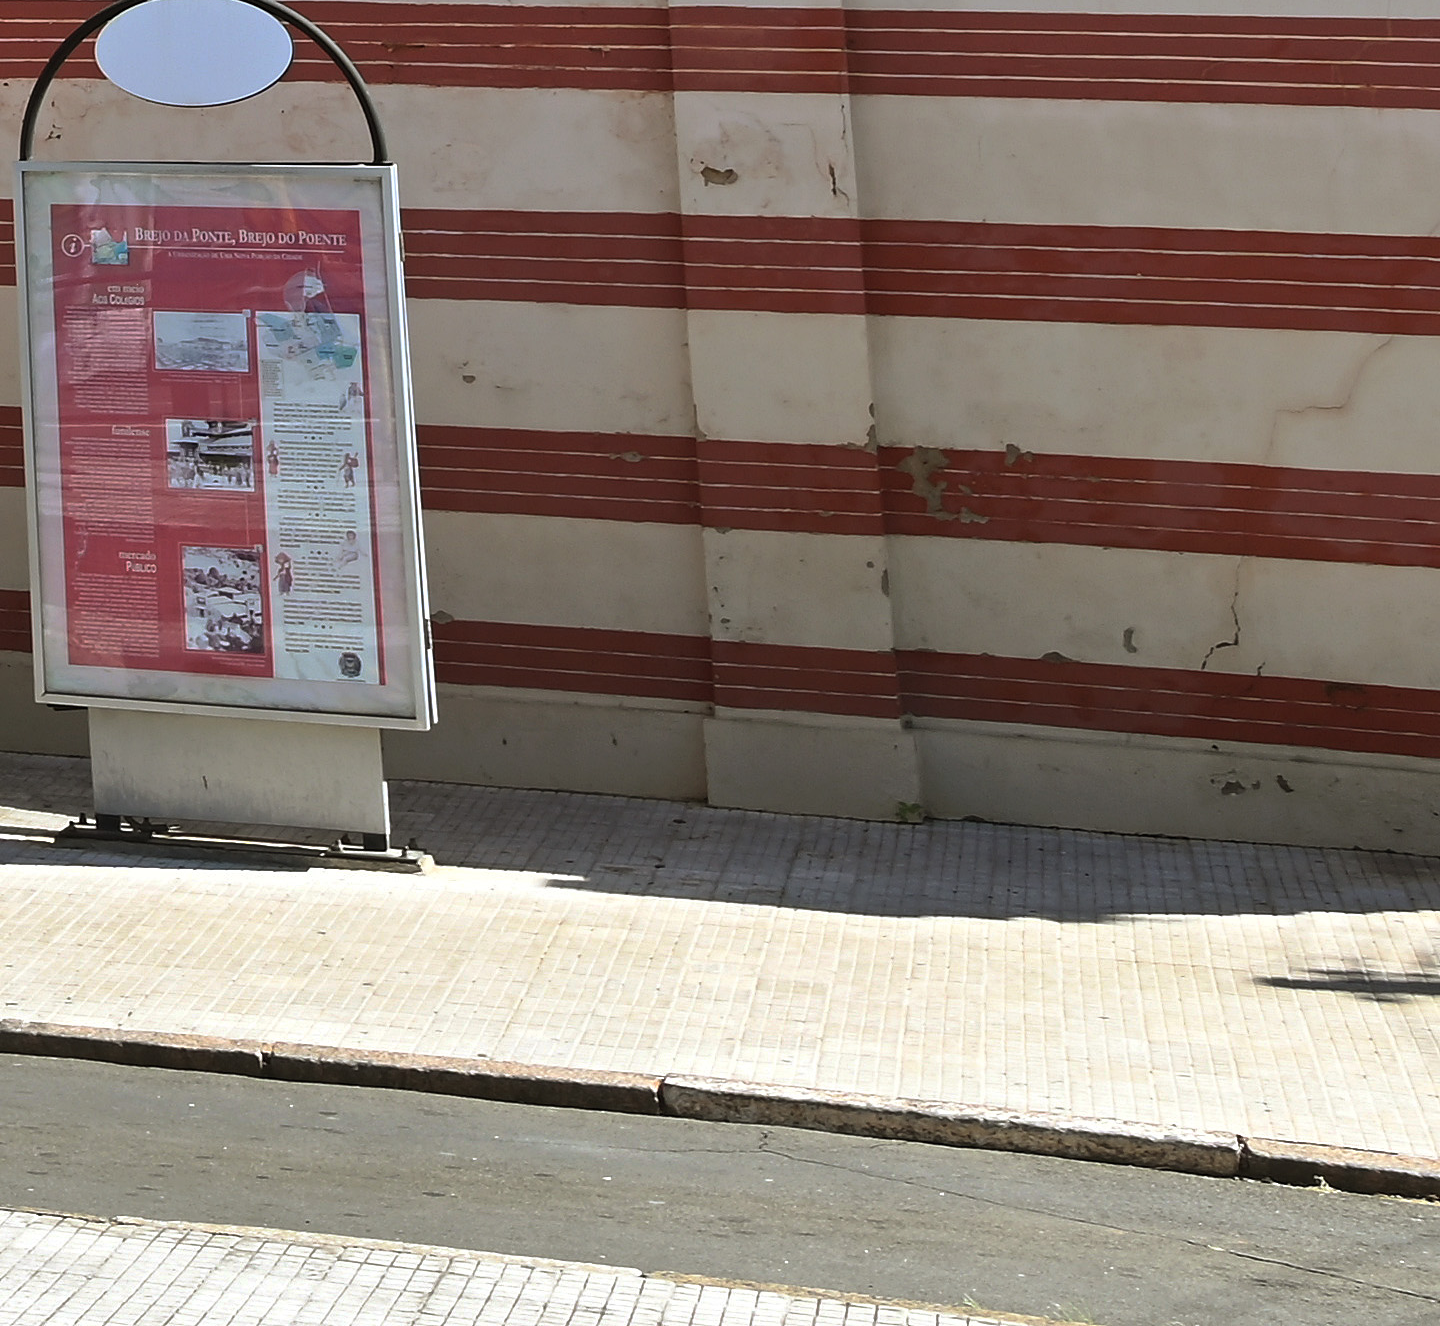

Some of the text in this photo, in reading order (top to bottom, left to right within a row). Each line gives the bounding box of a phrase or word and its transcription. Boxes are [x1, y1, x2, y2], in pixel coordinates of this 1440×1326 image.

[135, 227, 347, 247] BREJO DA PONTE, BREJO DO POENTE
